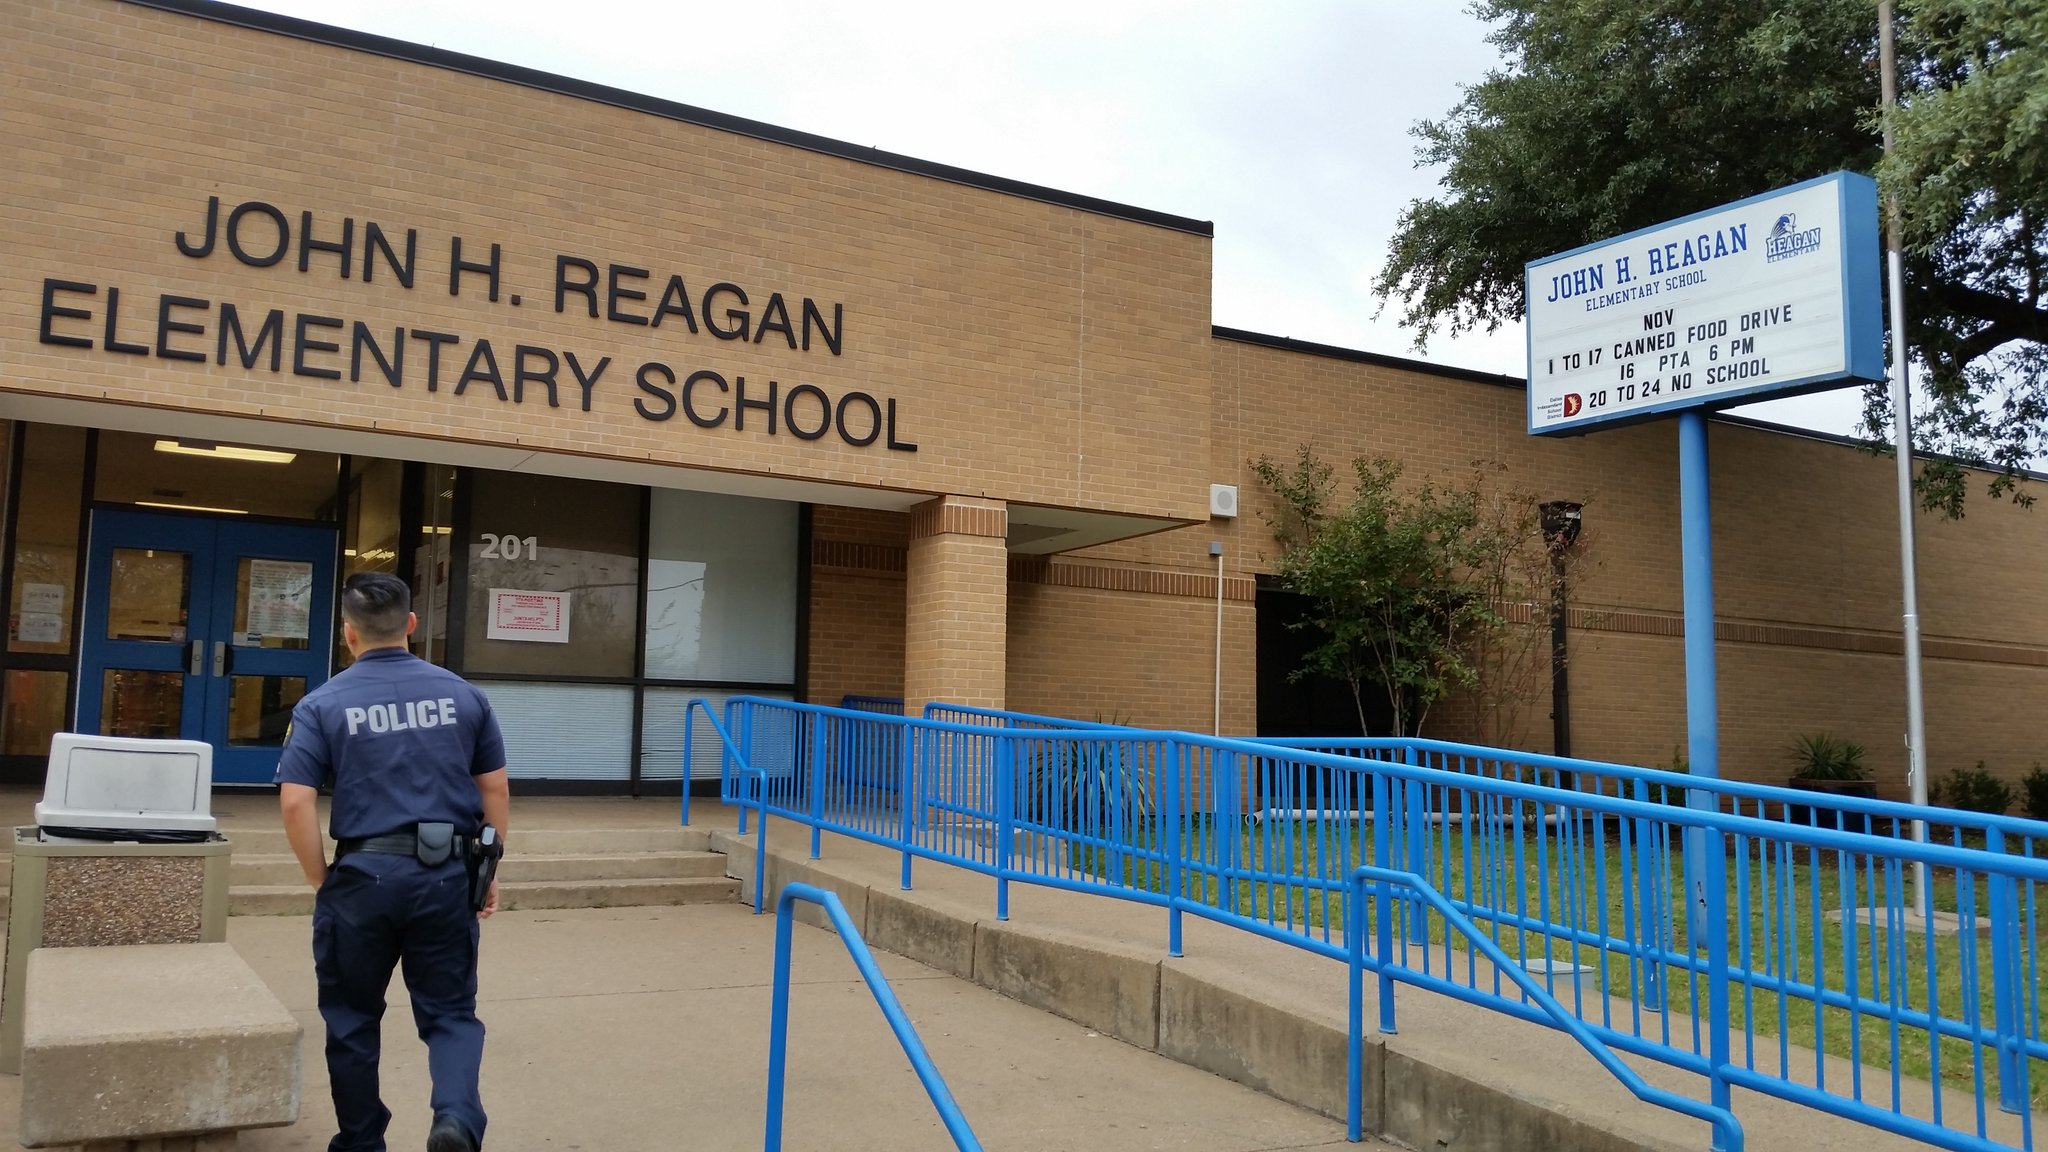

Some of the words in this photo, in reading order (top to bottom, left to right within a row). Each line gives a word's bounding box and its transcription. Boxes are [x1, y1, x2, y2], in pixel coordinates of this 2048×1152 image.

[1548, 264, 1603, 302] JOHN
[1616, 256, 1637, 284] H.
[1648, 223, 1747, 275] REAGAN
[1766, 227, 1821, 257] REAGAN
[175, 196, 416, 288] JOHN
[449, 236, 520, 305] H.
[555, 255, 842, 355] REAGAN
[1586, 281, 1660, 311] ELEMENTARY
[1666, 270, 1707, 291] SCHOOL
[1563, 353, 1580, 371] TO
[1589, 348, 1602, 366] 17
[1614, 331, 1675, 359] CANNED
[1688, 319, 1727, 343] FOOD
[1741, 304, 1791, 332] DRIVE
[1643, 308, 1673, 331] NOV
[40, 278, 611, 411] ELEMENTARY
[634, 362, 918, 451] SCHOOL
[1620, 363, 1634, 380] 16
[1659, 351, 1690, 372] PTA
[1709, 344, 1718, 361] 6
[1731, 336, 1754, 357] PM
[1589, 390, 1606, 408] 20
[1617, 384, 1634, 402] TO
[1642, 379, 1660, 397] 24
[1671, 373, 1691, 391] NO
[1707, 358, 1770, 385] SCHOOL
[480, 533, 537, 561] 201
[345, 698, 457, 735] POLICE
